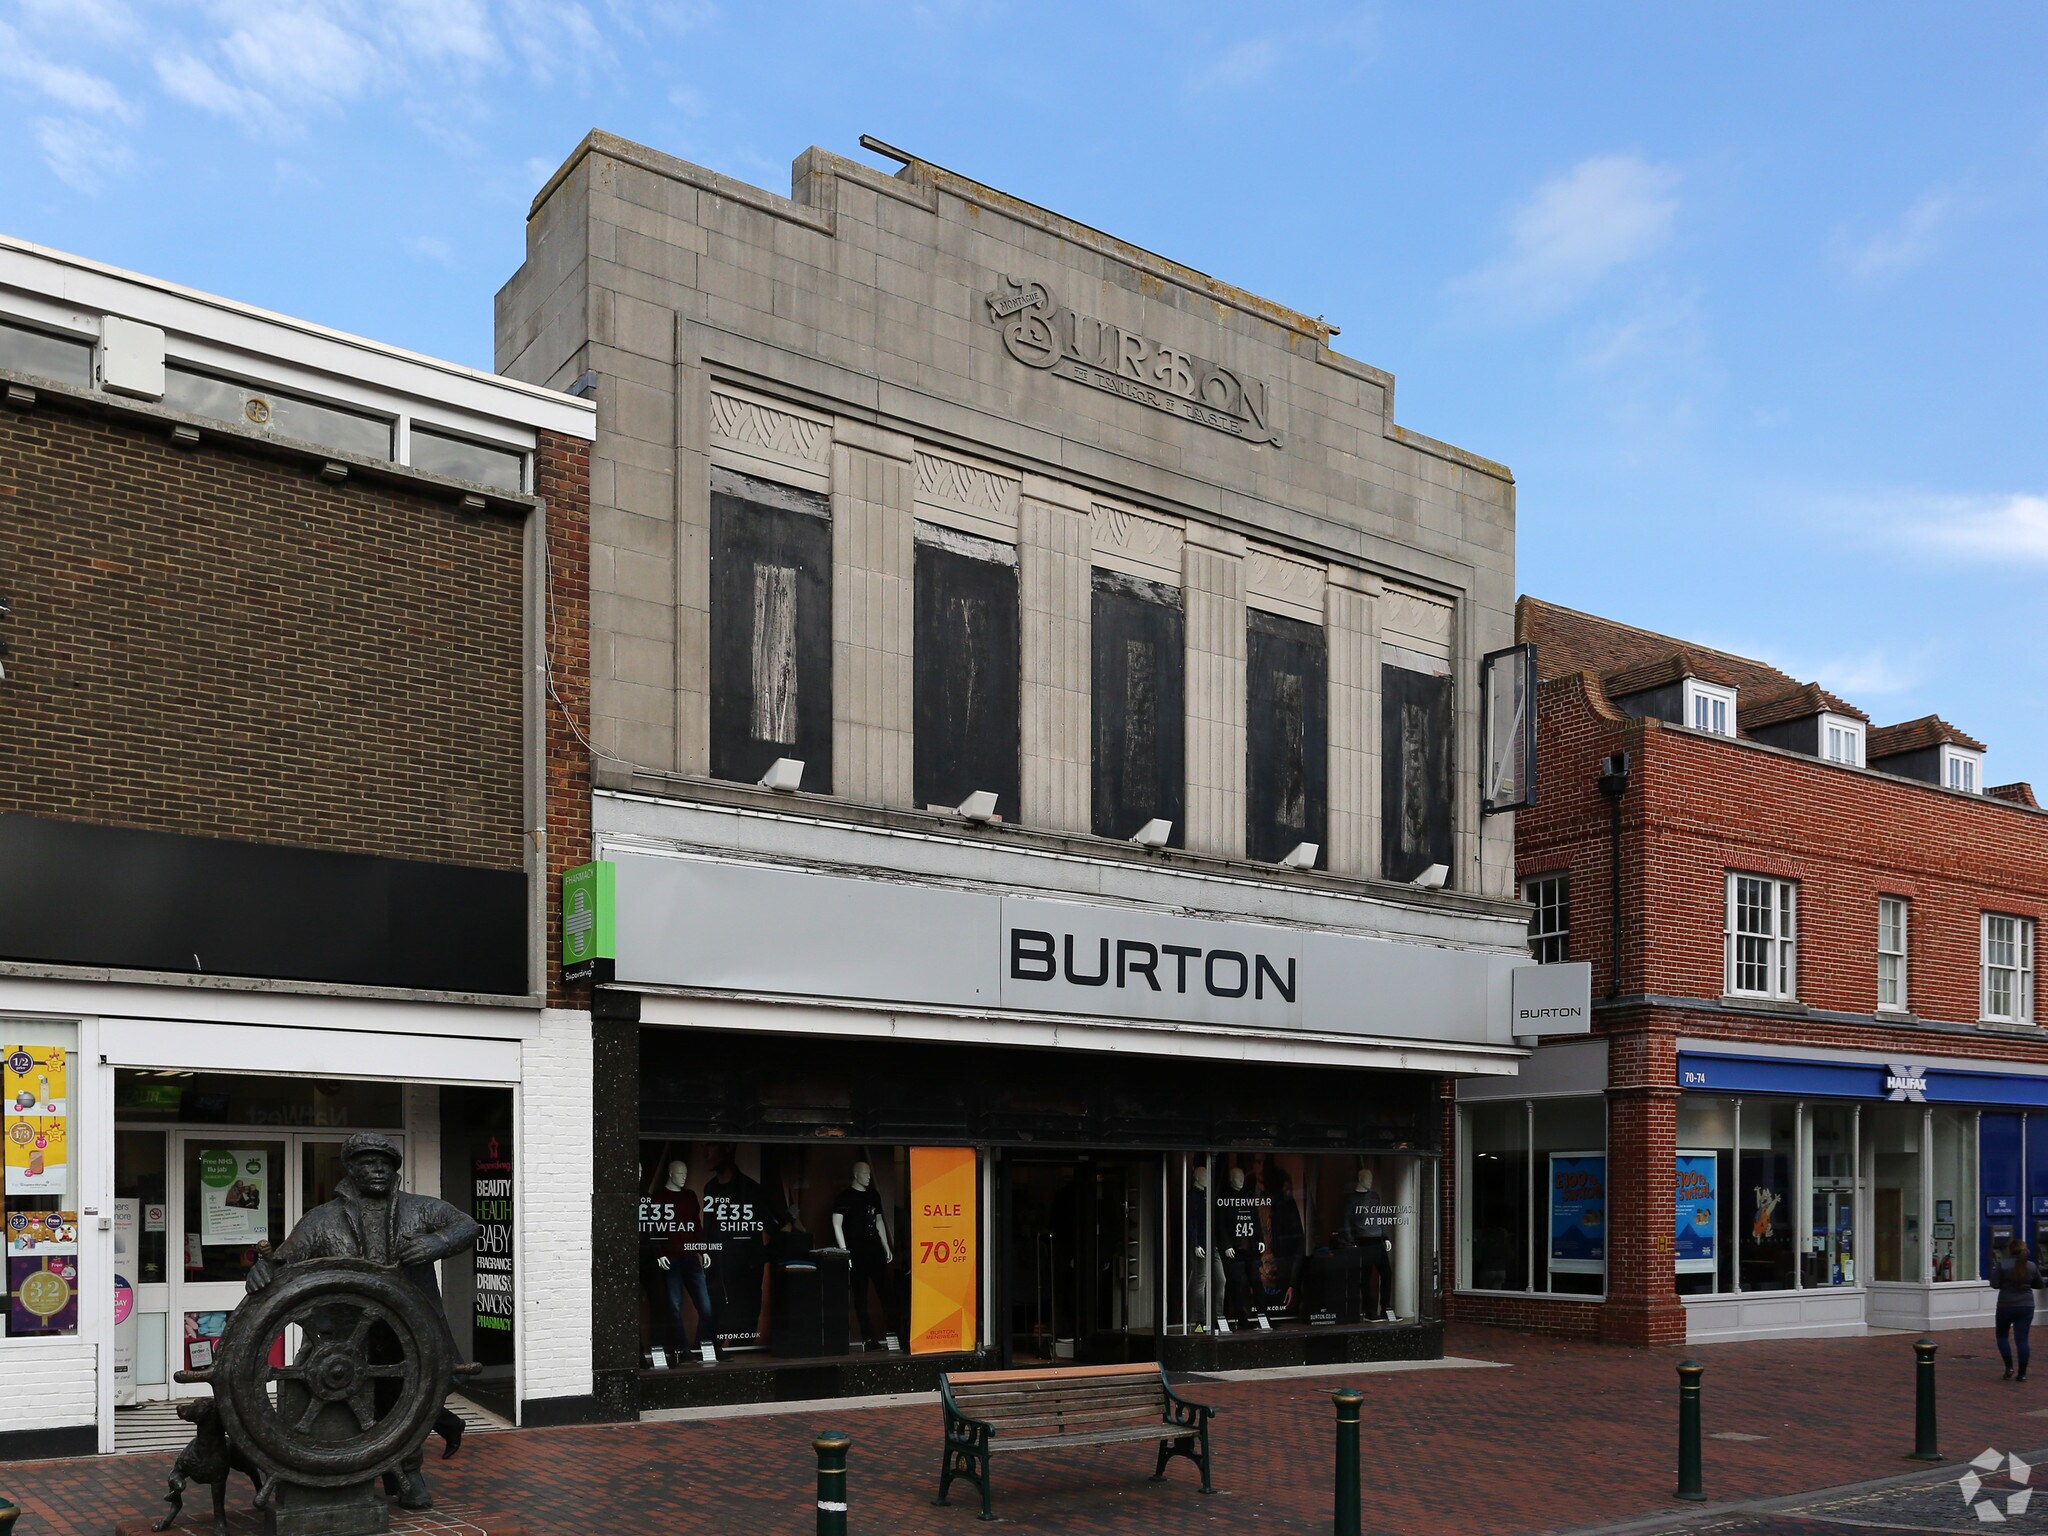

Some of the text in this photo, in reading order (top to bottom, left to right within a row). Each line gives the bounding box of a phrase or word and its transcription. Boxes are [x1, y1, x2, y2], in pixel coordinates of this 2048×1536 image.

[1000, 292, 1040, 312] MONTAGUE
[1002, 272, 1272, 432] BURTON
[565, 869, 594, 886] PHARMACY
[1011, 928, 1296, 1003] BURTON
[1520, 1007, 1581, 1019] BURTON
[13, 1057, 29, 1067] 1/2
[1684, 1072, 1706, 1084] 70-74
[1887, 1076, 1928, 1090] HALIFAX
[14, 1129, 30, 1139] 1/3
[476, 1180, 511, 1197] BEAUTY
[703, 1195, 715, 1213] 2
[1216, 1198, 1272, 1207] OUTERWEAR
[1355, 1206, 1370, 1214] IT'S
[476, 1201, 512, 1220] HEALTH
[716, 1203, 754, 1221] £35
[923, 1204, 961, 1217] SALE
[720, 1221, 764, 1232] SHIRTS
[1364, 1217, 1410, 1226] AT BURTON
[1235, 1222, 1254, 1237] £45
[476, 1223, 511, 1253] BABY
[683, 1243, 723, 1251] SELECTED LINES
[920, 1240, 950, 1264] 70
[476, 1256, 512, 1271] FRAGRANCE
[476, 1292, 513, 1315] SNACKS
[476, 1315, 512, 1331] PHARMACY
